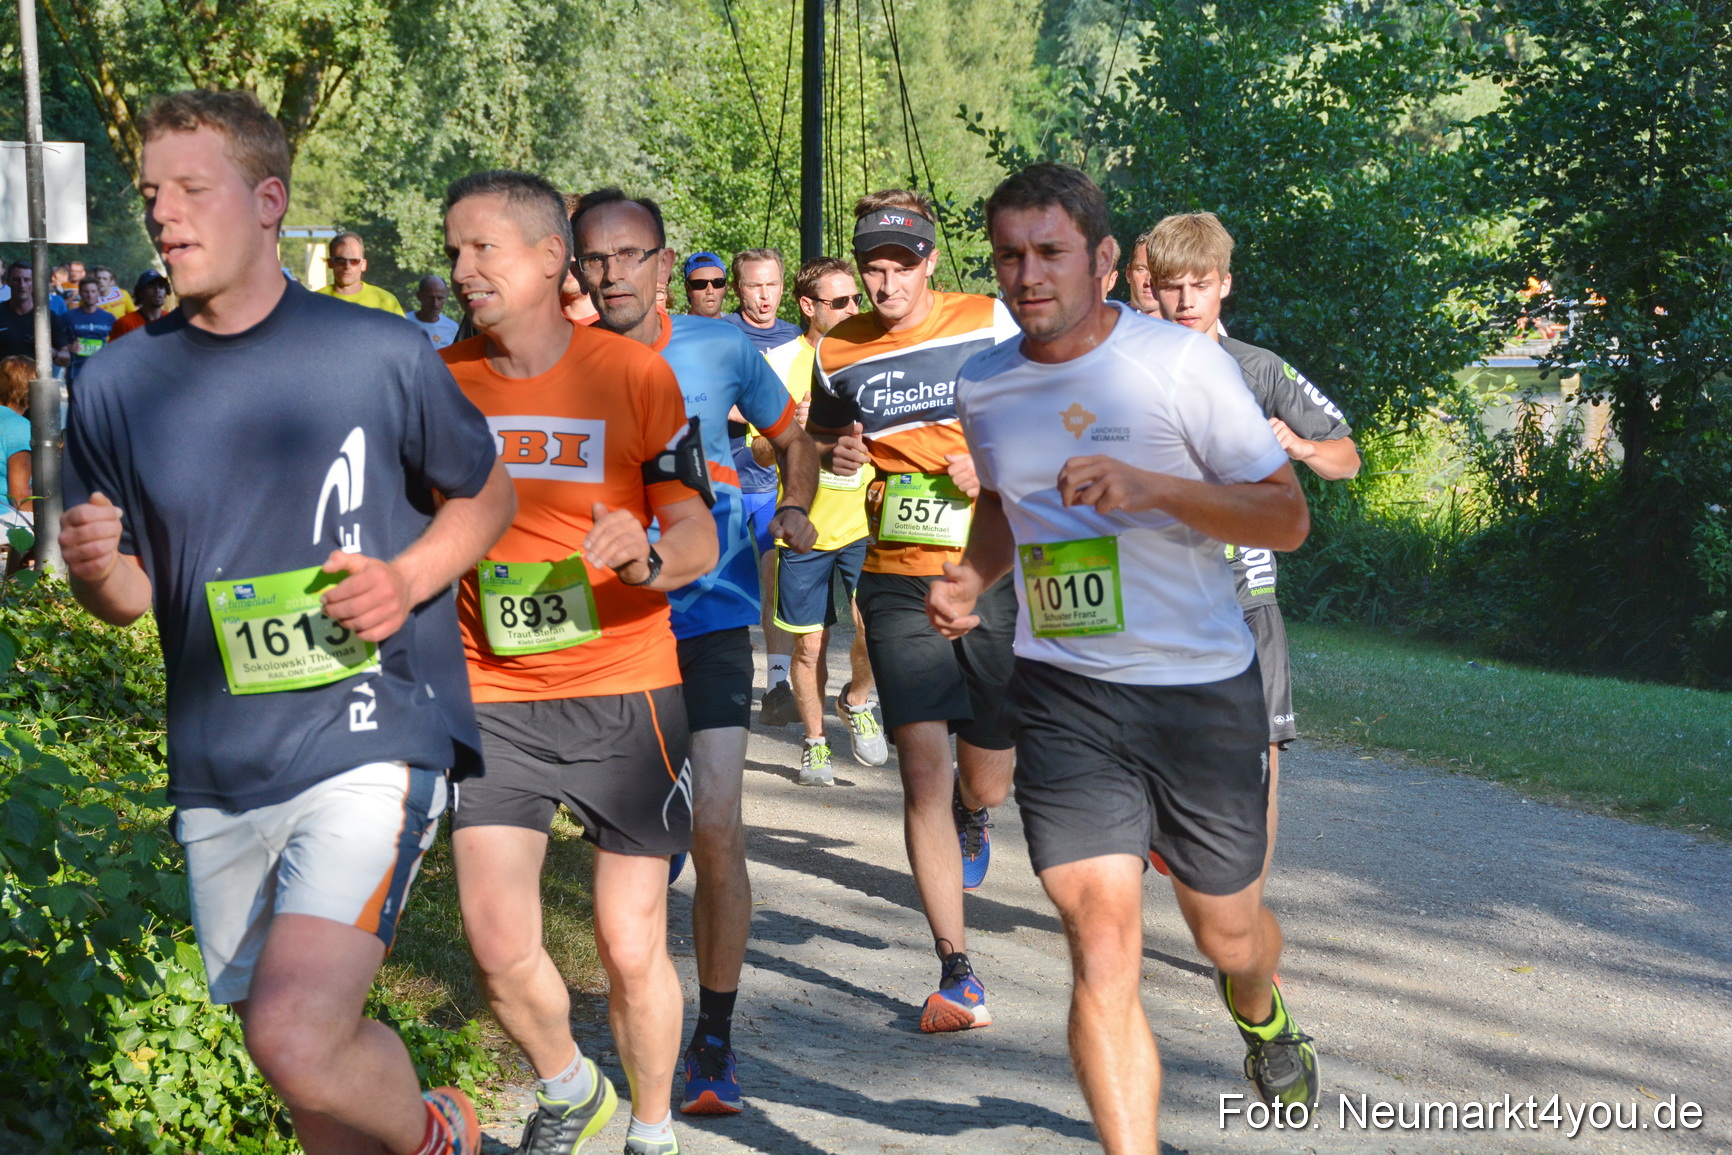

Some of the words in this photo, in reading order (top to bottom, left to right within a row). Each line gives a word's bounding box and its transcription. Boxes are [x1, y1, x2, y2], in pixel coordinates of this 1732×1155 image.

[873, 380, 955, 408] Fischer
[497, 429, 590, 468] BI
[1091, 434, 1130, 442] NEUMARKT
[897, 497, 949, 524] 557
[894, 522, 921, 531] Gottlieb
[922, 524, 950, 533] Michael
[1033, 573, 1104, 611] 1010
[499, 594, 568, 629] 893
[1073, 610, 1097, 619] Franz
[235, 612, 350, 660] 1613
[507, 630, 532, 639] Traut
[533, 627, 565, 638] Stefan
[242, 659, 307, 673] Sokolowski
[308, 646, 356, 664] Thomas
[307, 663, 333, 674] GmbH
